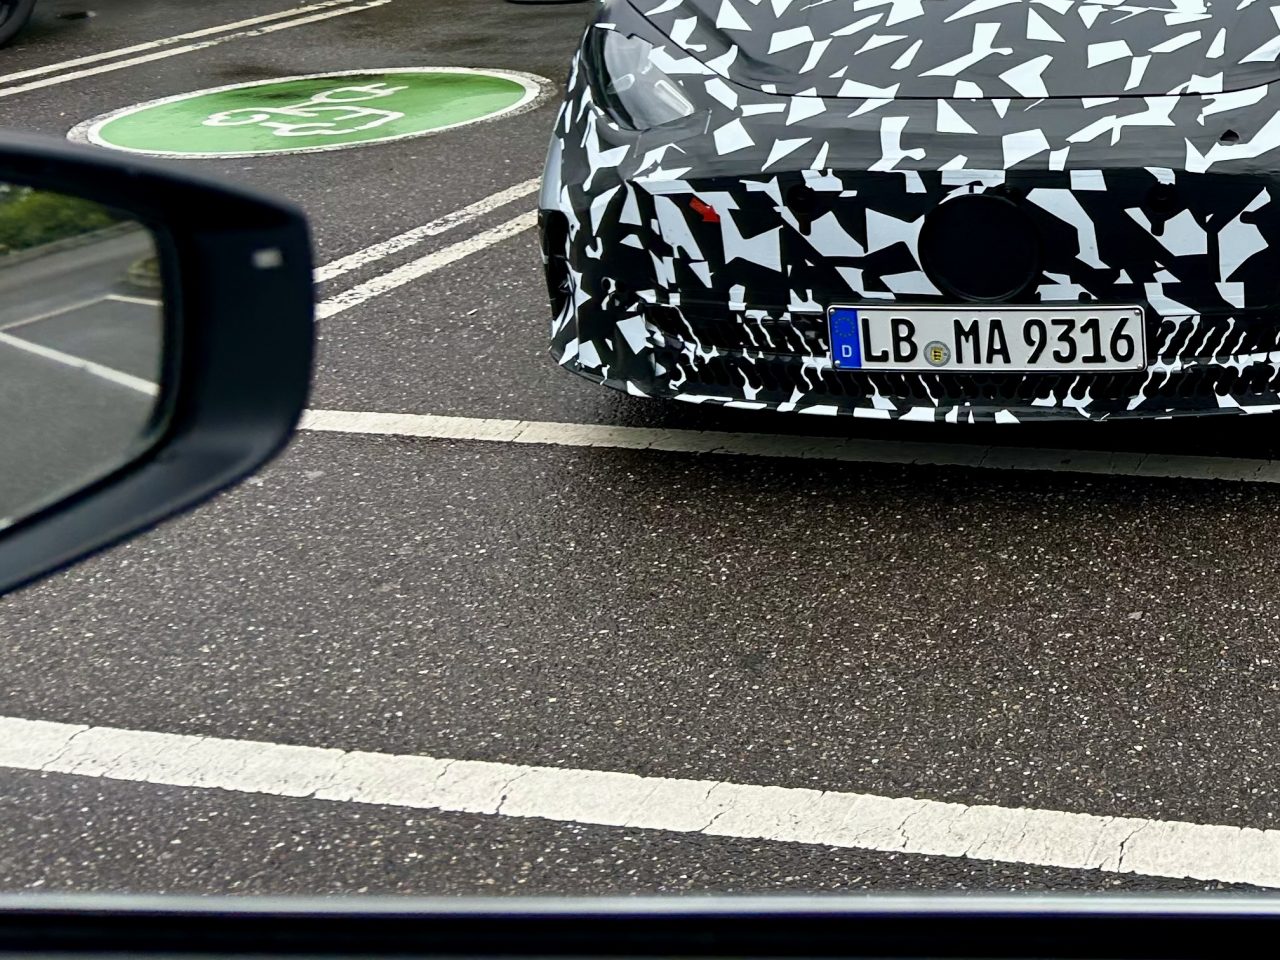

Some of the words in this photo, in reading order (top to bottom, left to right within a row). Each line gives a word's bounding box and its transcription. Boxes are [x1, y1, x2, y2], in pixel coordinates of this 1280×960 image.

[841, 345, 853, 358] D
[861, 317, 919, 363] LB
[953, 319, 1011, 364] MA
[1022, 317, 1135, 364] 9316
